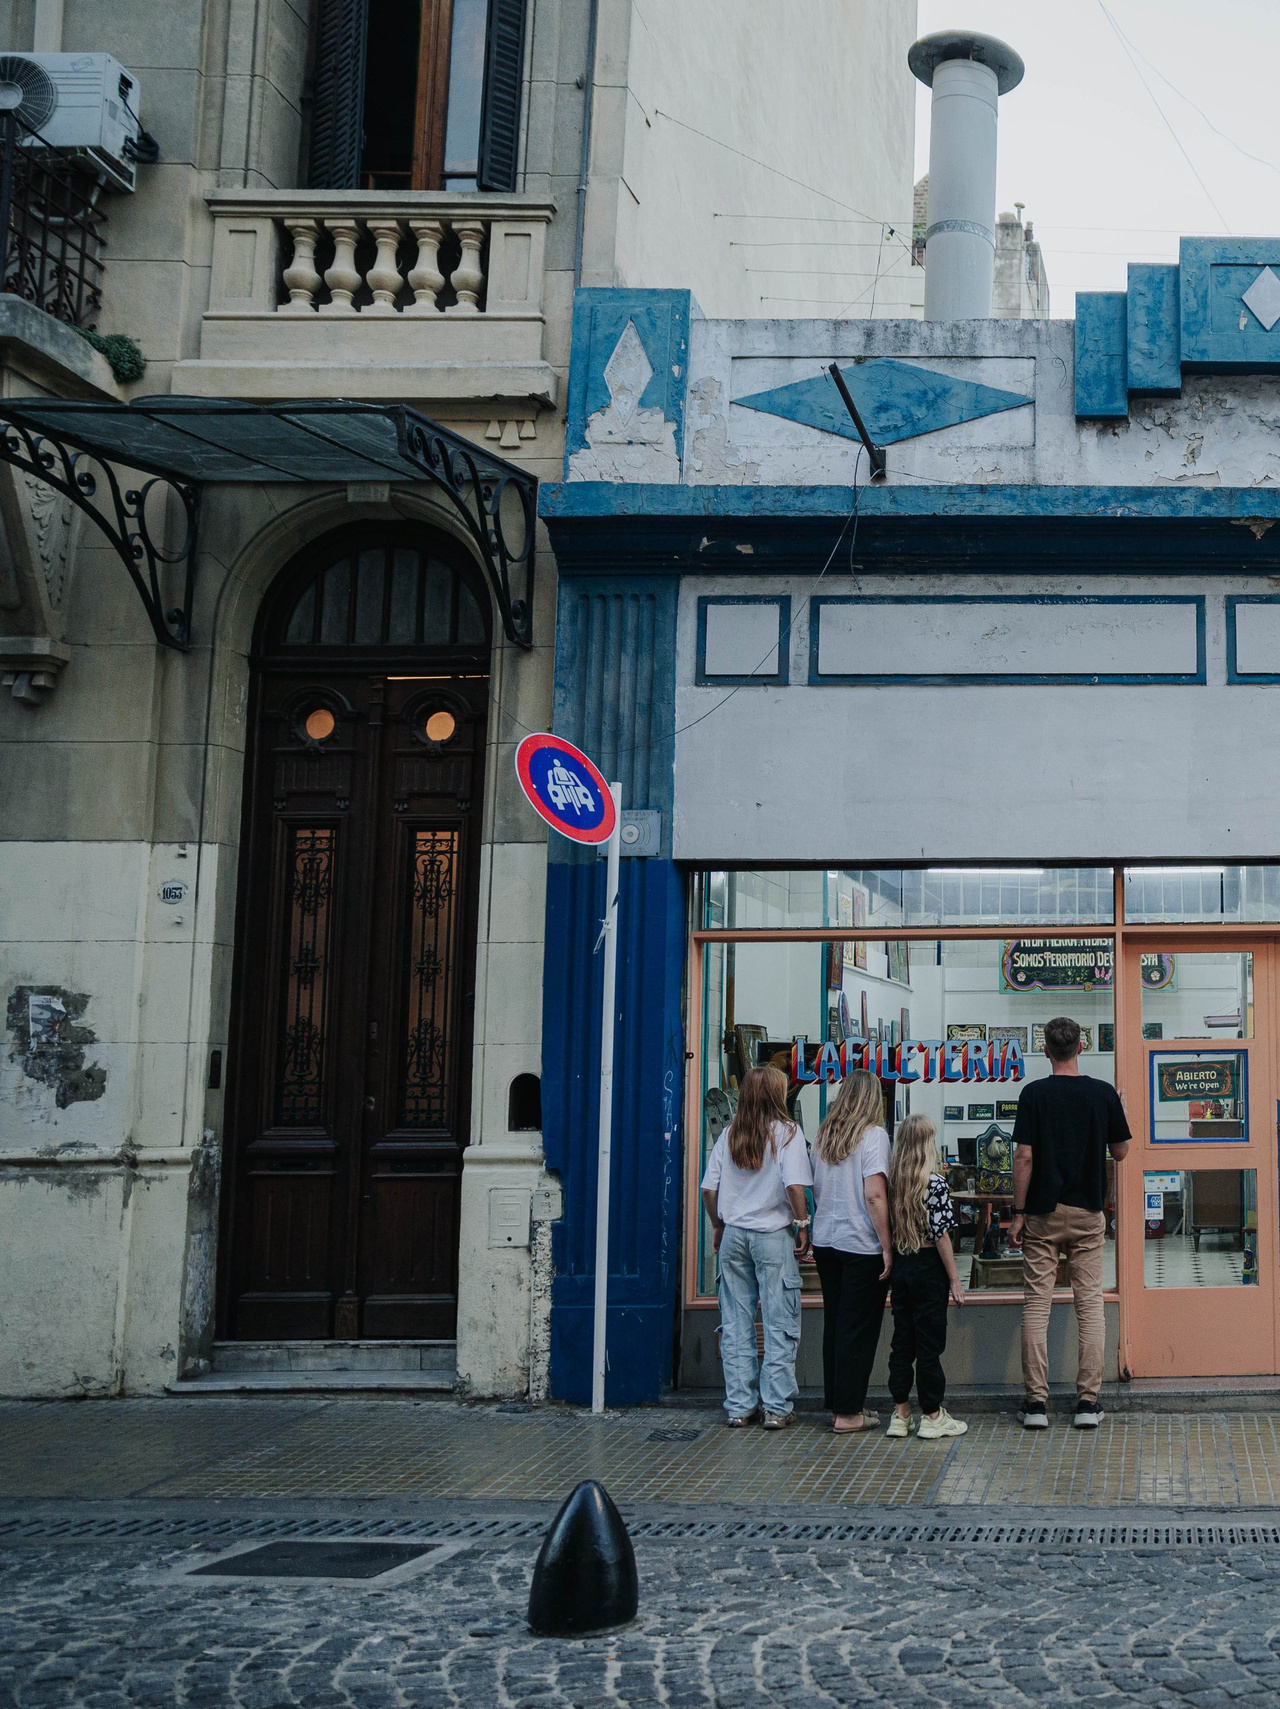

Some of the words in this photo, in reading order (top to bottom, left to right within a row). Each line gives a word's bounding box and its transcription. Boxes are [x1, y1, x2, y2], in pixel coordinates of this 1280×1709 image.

[162, 886, 183, 900] 1053
[1013, 951, 1044, 967] SOMOS
[1044, 951, 1095, 967] TERRITORIO
[1176, 1070, 1217, 1081] ABIERTO
[1175, 1082, 1198, 1091] We're
[1199, 1081, 1220, 1091] Open
